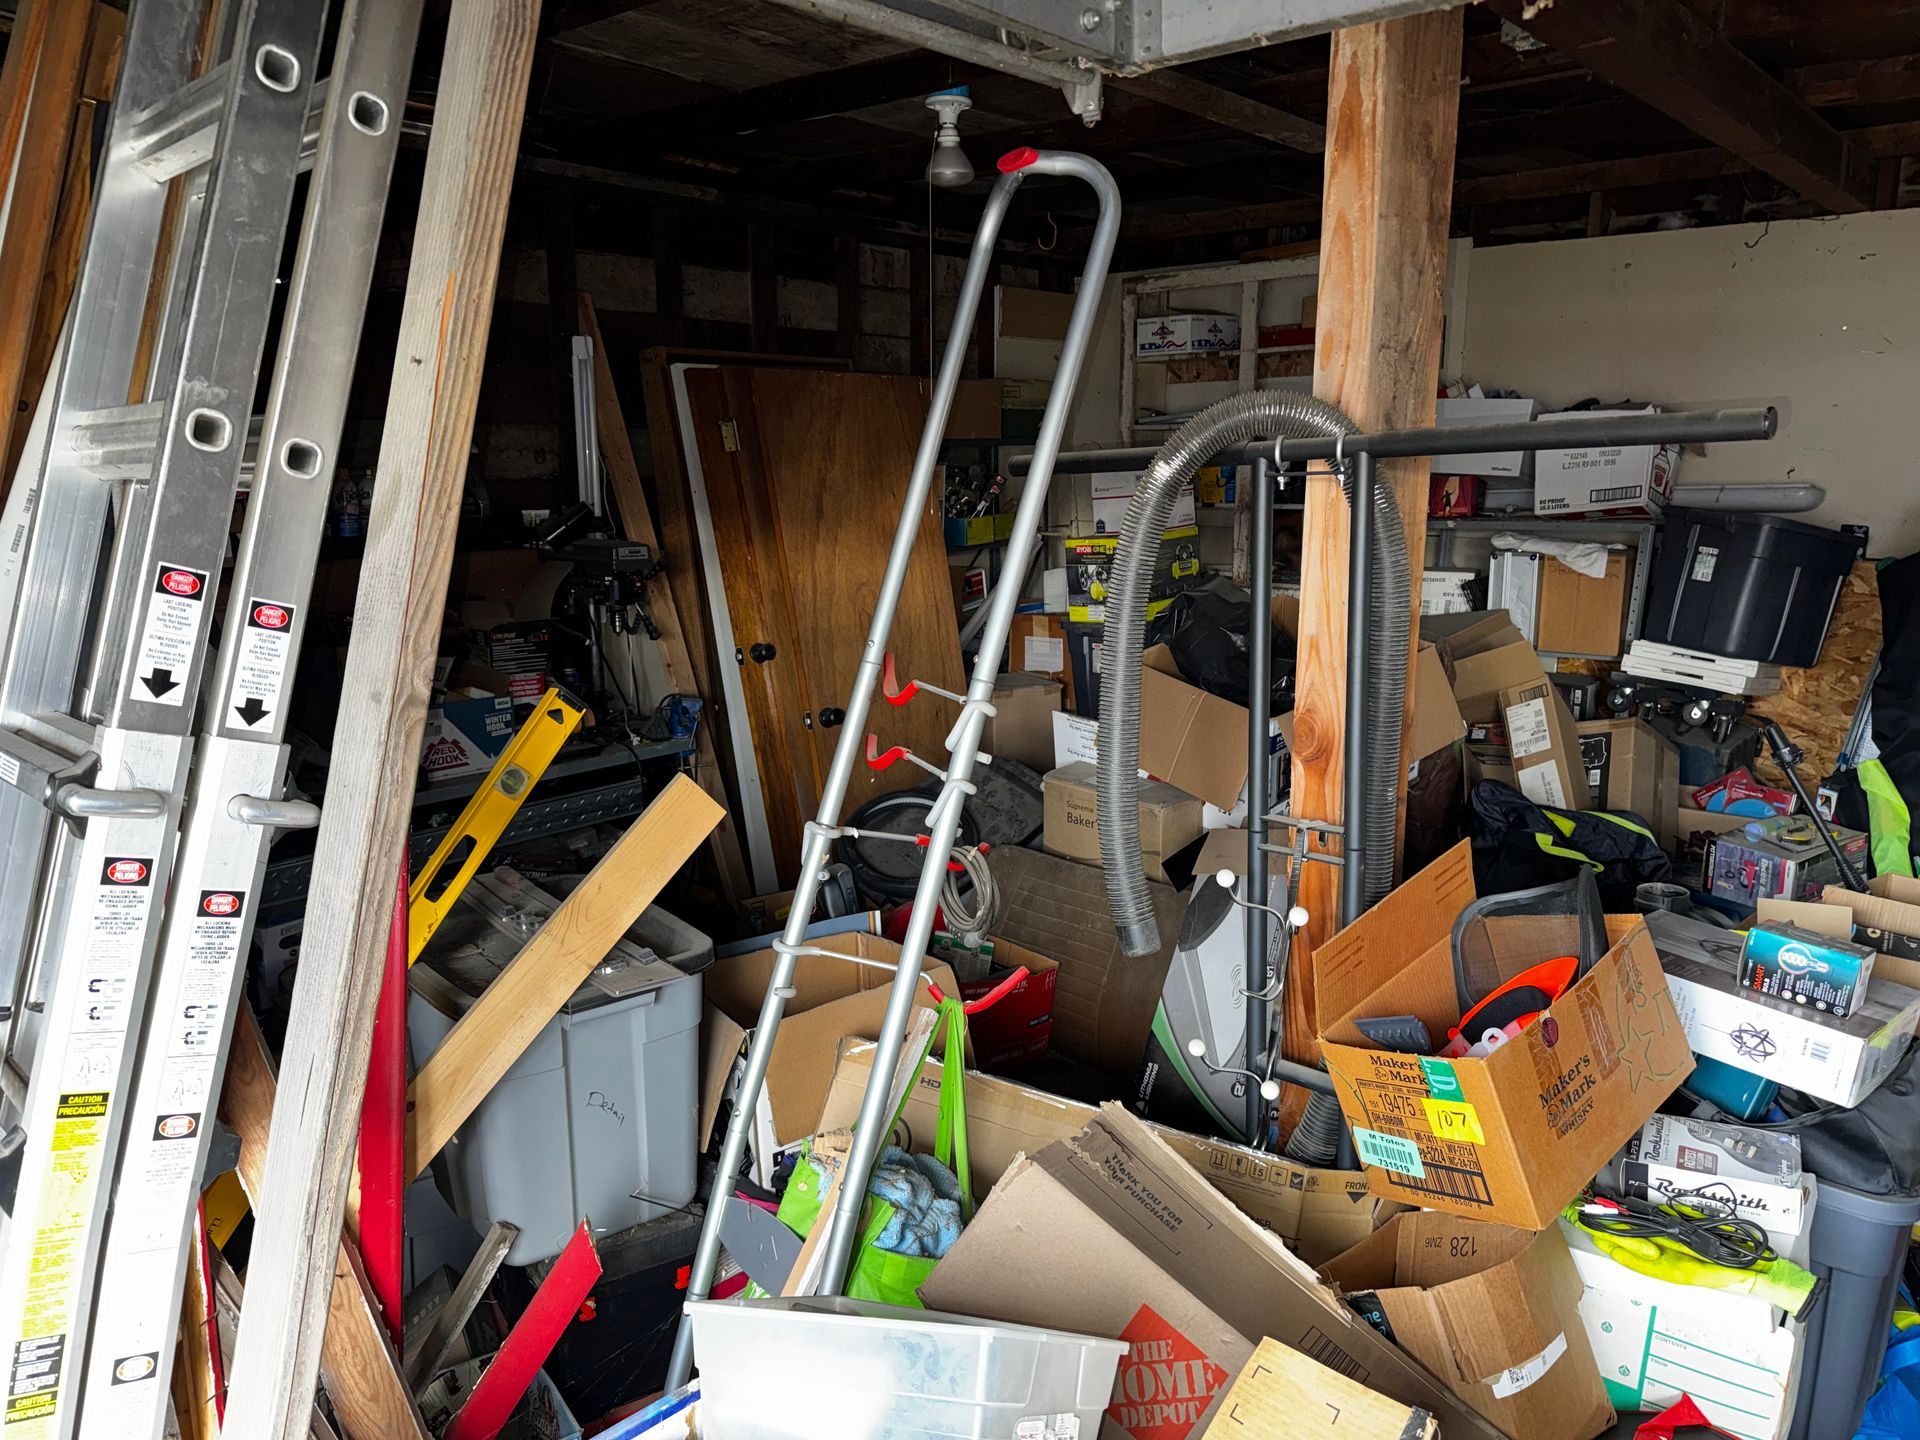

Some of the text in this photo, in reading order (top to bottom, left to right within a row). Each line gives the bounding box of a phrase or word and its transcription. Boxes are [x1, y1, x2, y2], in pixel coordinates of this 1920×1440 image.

[170, 572, 193, 583] DANGER
[168, 581, 192, 593] PELIGRO
[261, 607, 282, 616] DANGER
[260, 616, 281, 625] PELIGRO
[485, 714, 511, 724] WINTER
[486, 723, 505, 732] HOOK
[432, 746, 455, 756] RED
[427, 754, 463, 767] HOOK
[1066, 801, 1094, 814] Supreme
[114, 872, 139, 880] PELIGRO
[209, 904, 232, 912] PELIGRO
[1753, 964, 1765, 990] SMART
[1762, 978, 1770, 992] BULB
[1369, 1055, 1422, 1070] Maker's
[1138, 1062, 1154, 1098] LITHONIA
[1145, 1063, 1158, 1100] LIGHTING
[1390, 1070, 1428, 1085] Mark
[1539, 1054, 1590, 1110] Maker's
[68, 1095, 103, 1104] CAUTION
[1559, 1073, 1596, 1115] Mark
[58, 1105, 105, 1115] PRECAUCIÓN
[1378, 1092, 1416, 1116] 19475
[1438, 1110, 1466, 1129] 107
[1560, 1100, 1594, 1137] WHISKY
[1380, 1136, 1405, 1147] Totes
[1644, 1116, 1664, 1162] Rocksmith
[1445, 1143, 1473, 1157] WV-2714
[1630, 1140, 1640, 1155] PS3
[1418, 1147, 1447, 1164] PA-5224
[1378, 1158, 1410, 1173] 731519
[1104, 1157, 1178, 1232] YOUR PURCHASE
[1112, 1153, 1183, 1225] THANK YOU FOR
[1655, 1177, 1770, 1212] Rocksmith
[1696, 1200, 1726, 1210] 2014
[1735, 1208, 1761, 1216] DITION
[1424, 1236, 1477, 1257] 128 ZM6
[1654, 1334, 1687, 1350] CONTENTS
[1131, 1340, 1174, 1362] THE
[1651, 1358, 1668, 1368] FROM
[16, 1393, 52, 1409] CAUTION
[1120, 1401, 1200, 1428] DEPOT
